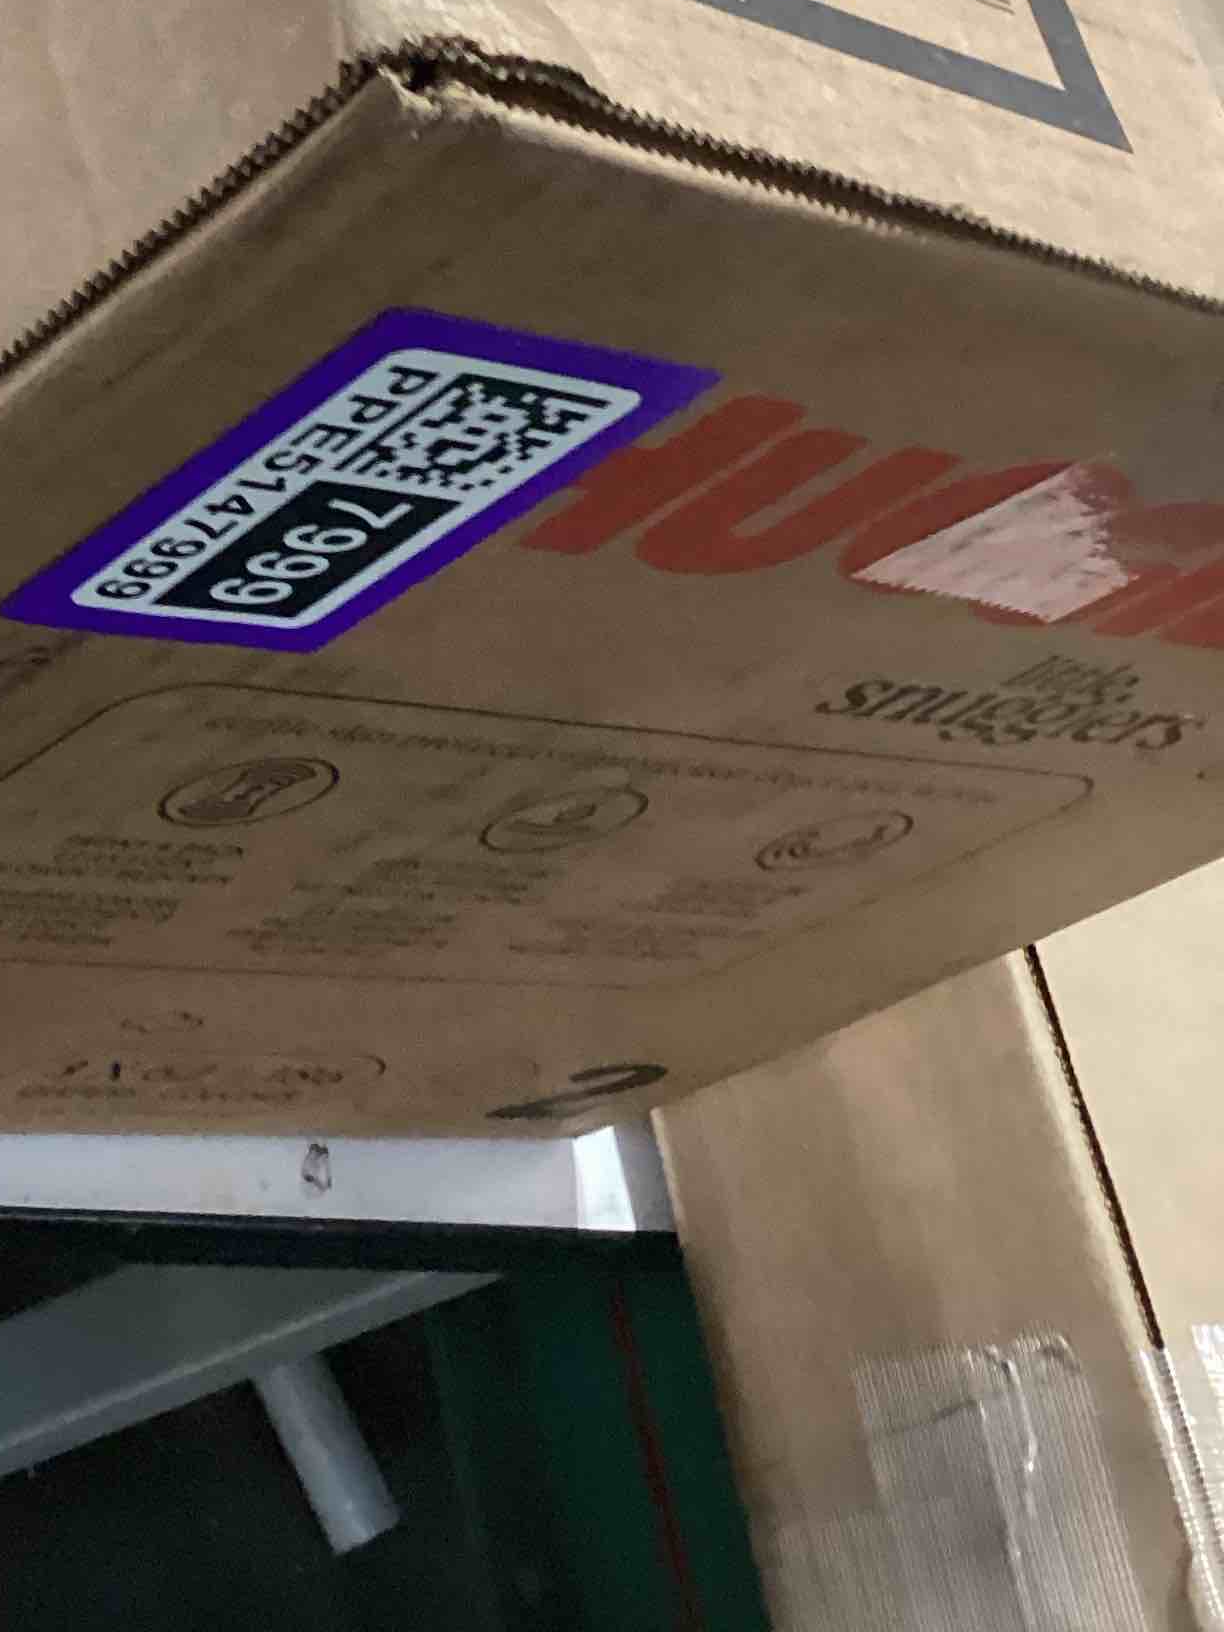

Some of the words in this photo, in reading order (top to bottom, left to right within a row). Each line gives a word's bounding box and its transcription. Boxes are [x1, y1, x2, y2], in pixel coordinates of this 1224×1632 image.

[96, 364, 441, 600] PPE5147999
[210, 496, 416, 607] 7999
[814, 671, 1186, 752] snugglers
